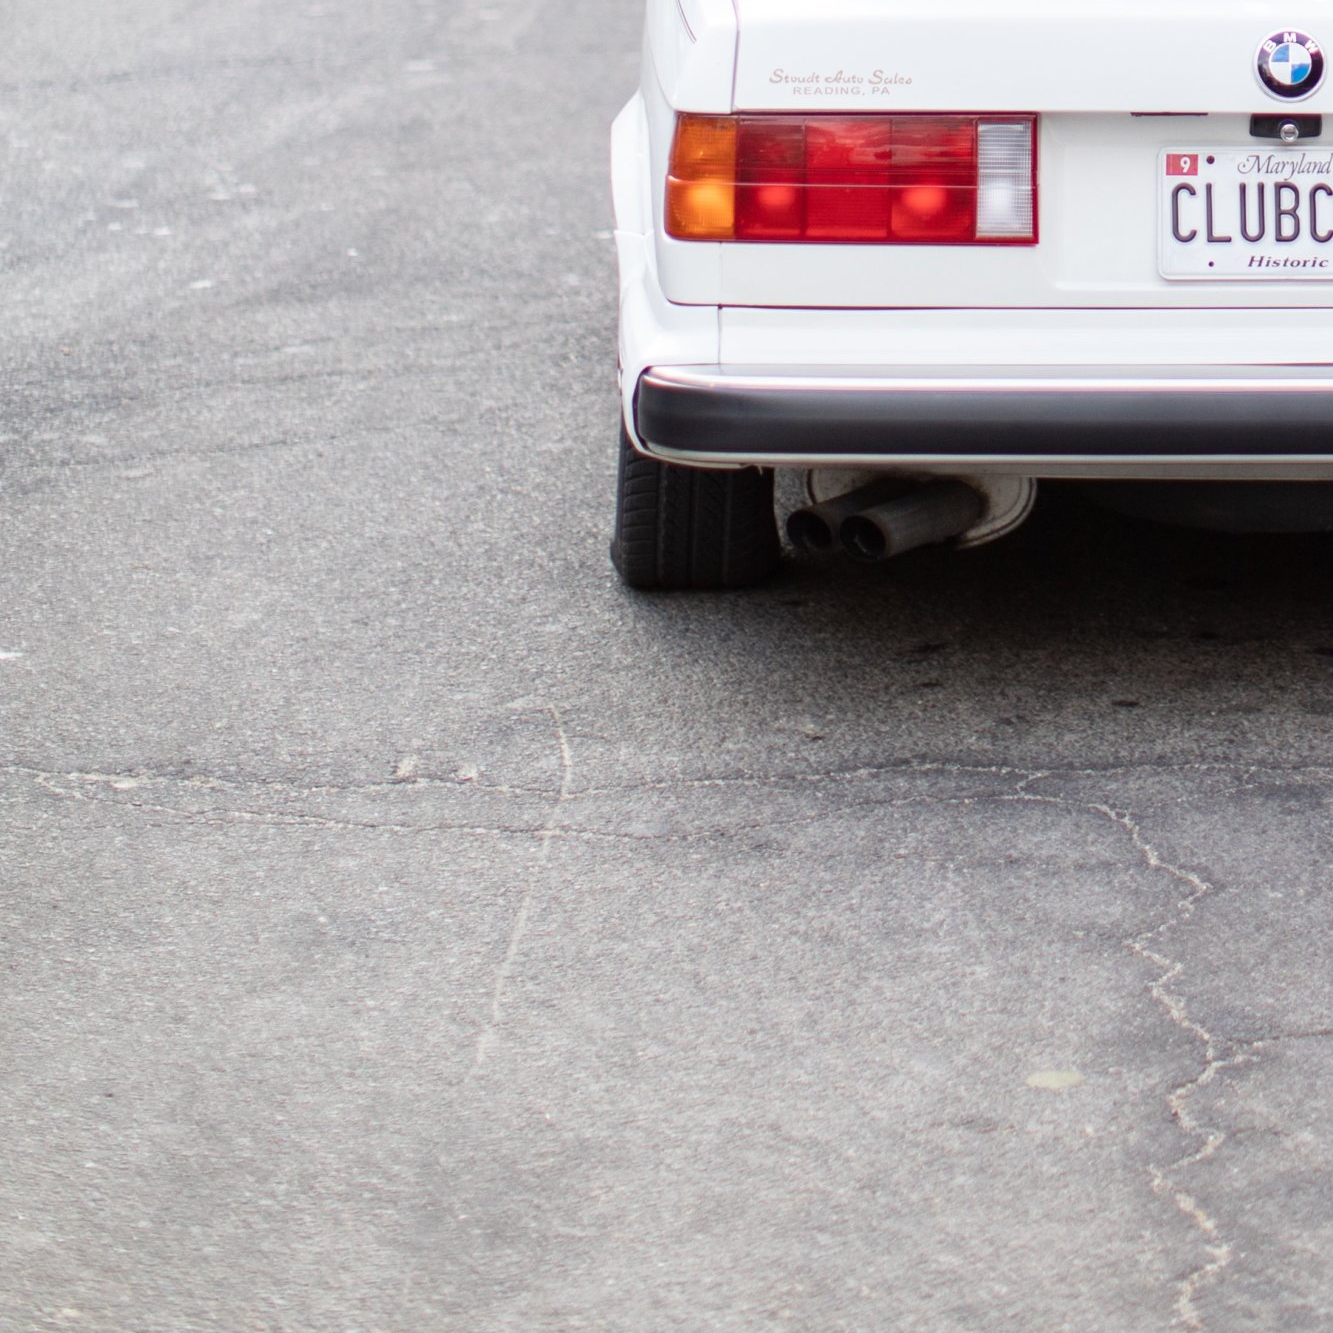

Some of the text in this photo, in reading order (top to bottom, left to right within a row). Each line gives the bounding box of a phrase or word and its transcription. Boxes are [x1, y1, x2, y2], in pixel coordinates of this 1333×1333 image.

[1262, 32, 1319, 54] BMW
[769, 69, 913, 85] Stoudt Auto Sales
[792, 86, 891, 96] READING, PA
[1179, 156, 1192, 174] 9
[1237, 152, 1333, 181] Maryland
[1248, 255, 1330, 268] Historic
